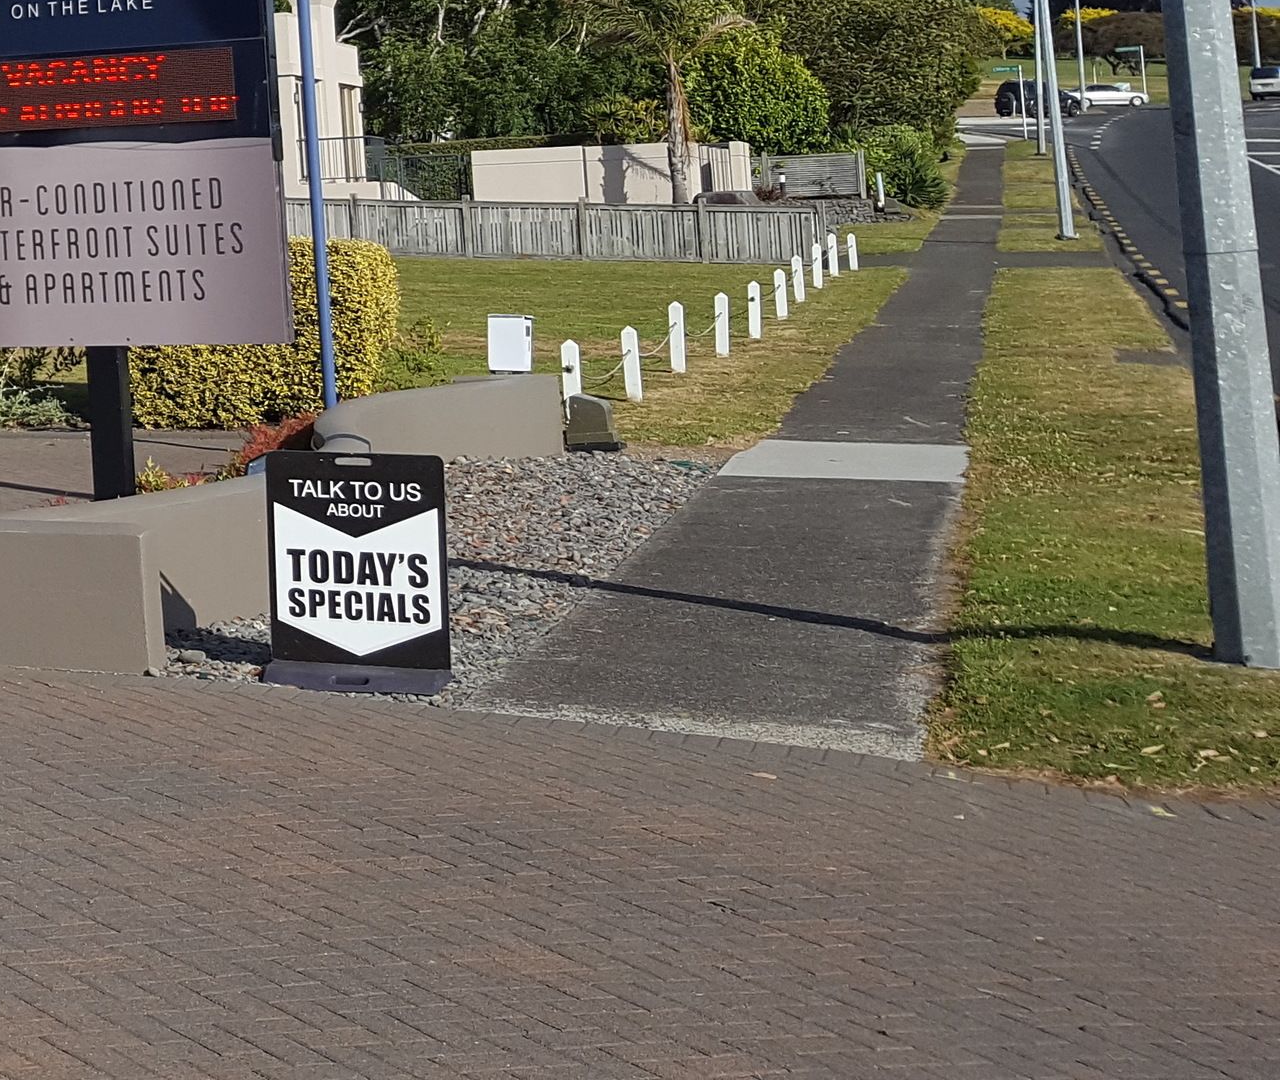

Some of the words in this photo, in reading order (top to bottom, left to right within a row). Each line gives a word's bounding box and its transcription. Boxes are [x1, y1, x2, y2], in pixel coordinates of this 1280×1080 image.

[11, 3, 39, 19] ON
[47, 0, 89, 16] THE
[0, 55, 166, 87] VACANCY
[147, 223, 244, 257] SUITES
[25, 269, 206, 305] APARTMENTS
[289, 479, 346, 499] TALK
[350, 481, 382, 500] TO
[390, 483, 421, 502] US
[326, 503, 385, 518] ABOUT
[286, 548, 429, 589] TODAY'S
[288, 587, 431, 625] SPECIALS
